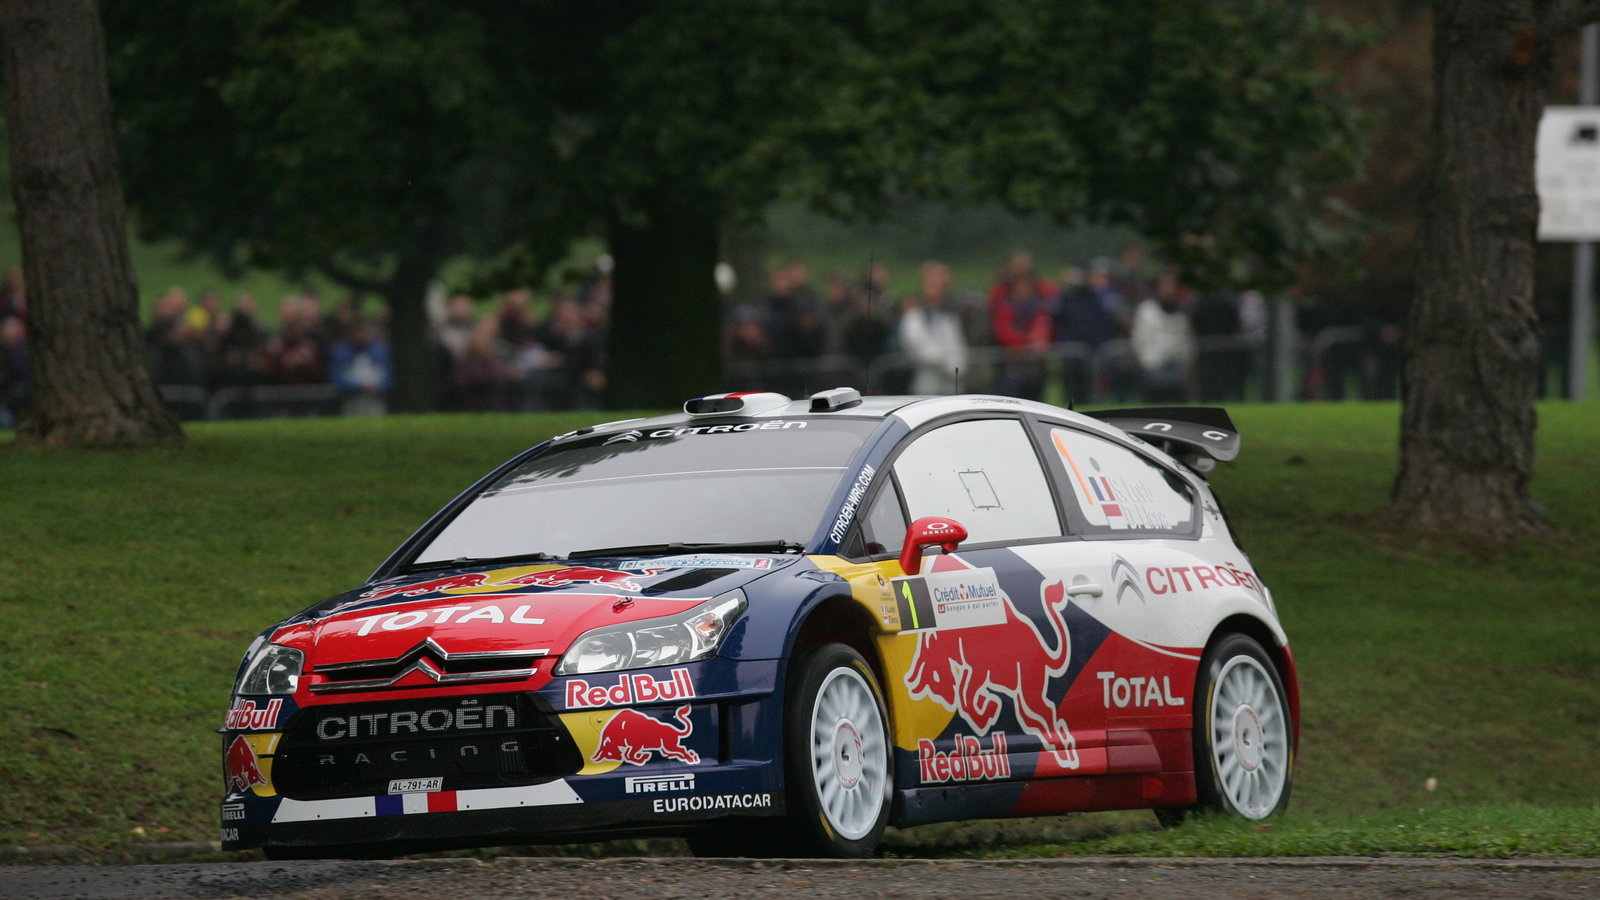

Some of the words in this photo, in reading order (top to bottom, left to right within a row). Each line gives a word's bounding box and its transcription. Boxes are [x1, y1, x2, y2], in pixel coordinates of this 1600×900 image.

[830, 464, 876, 544] CITROEN-WRC.COM
[902, 580, 919, 629] 1
[933, 586, 960, 603] Crédit
[967, 582, 998, 599] Mutuel
[355, 605, 545, 637] TOTAL
[1097, 671, 1185, 708] TOTAL
[391, 779, 439, 791] AL-791-AR
[625, 773, 695, 794] PIRELLI
[653, 794, 771, 813] EURODATACAR
